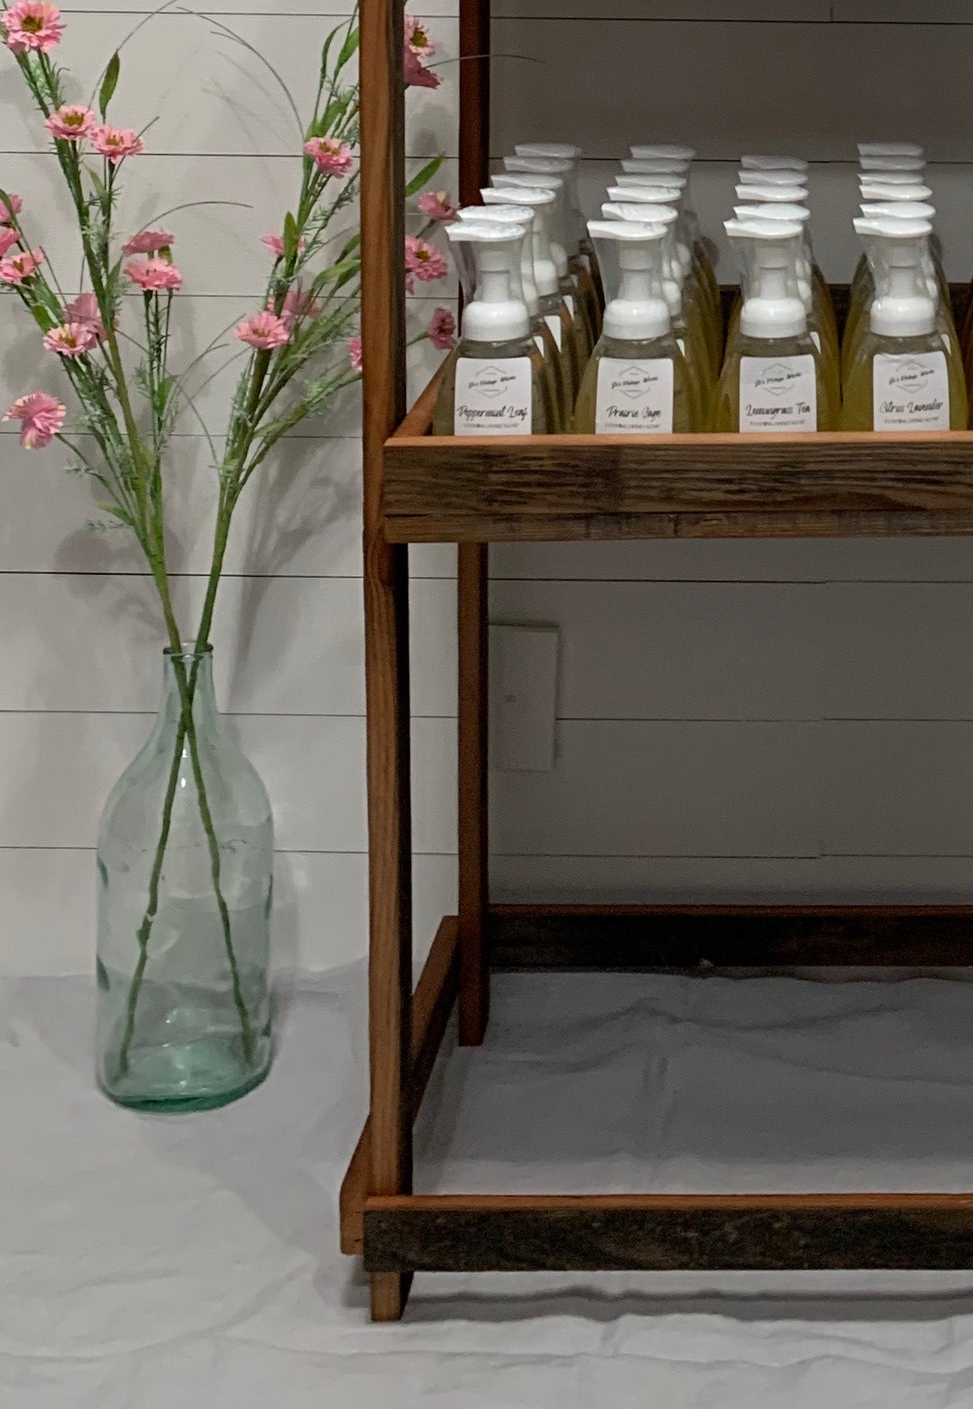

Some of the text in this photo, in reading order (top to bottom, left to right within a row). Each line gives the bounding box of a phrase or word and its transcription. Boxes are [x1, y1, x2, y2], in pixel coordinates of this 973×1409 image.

[457, 405, 528, 421] Peppermint Leaf
[606, 405, 639, 418] Prairie
[745, 401, 811, 420] Lemongrass Tea
[879, 398, 944, 414] Citrus Lavender
